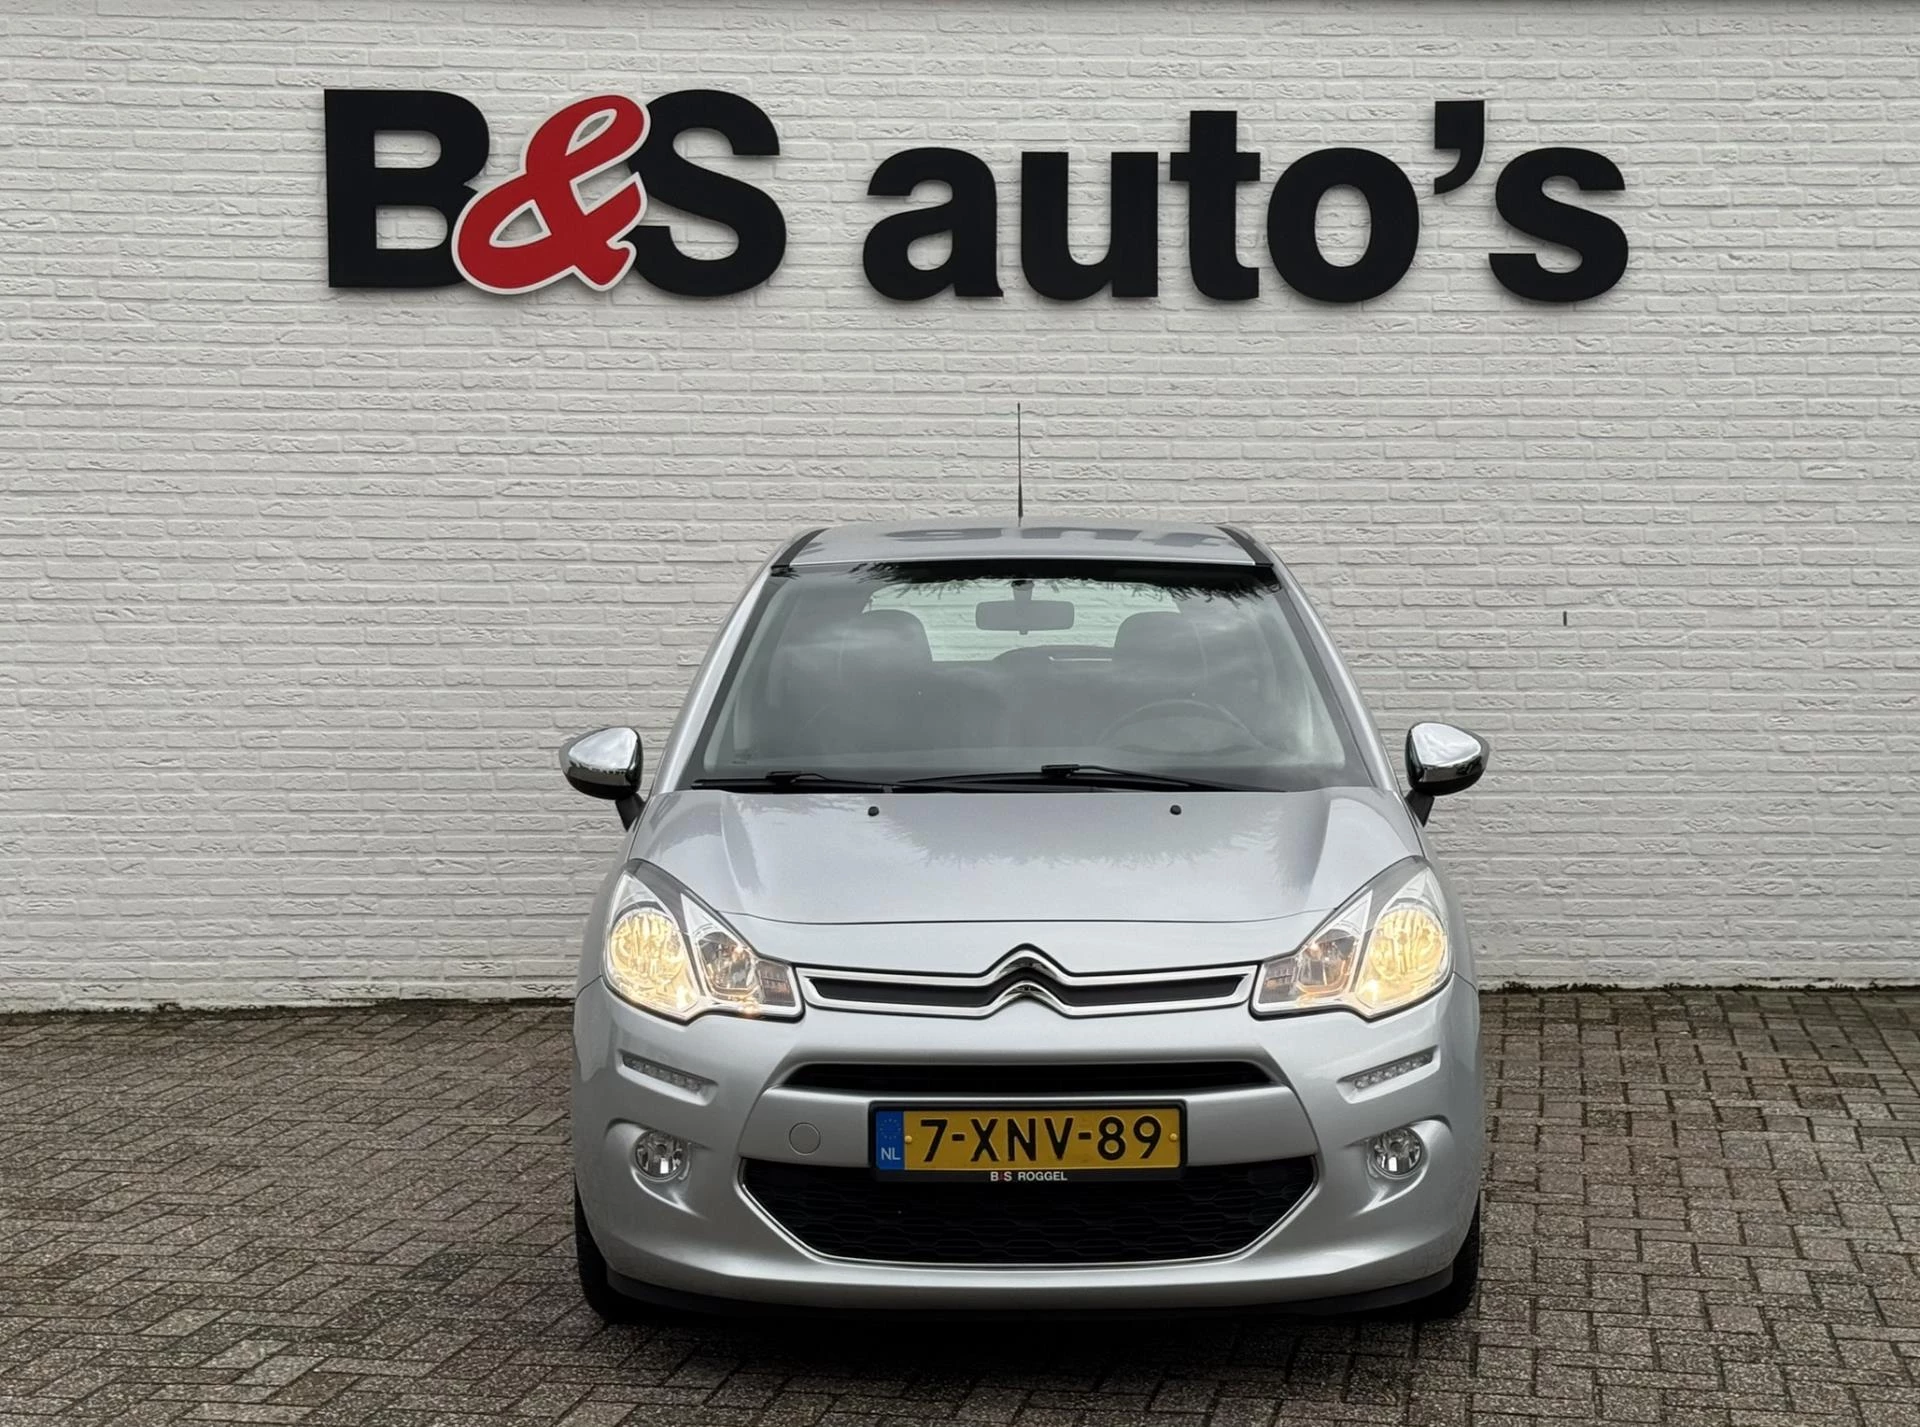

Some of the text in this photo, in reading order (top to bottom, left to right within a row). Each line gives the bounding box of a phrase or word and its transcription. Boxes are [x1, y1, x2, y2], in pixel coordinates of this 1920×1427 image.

[324, 88, 1628, 304] B&S auto's
[880, 1147, 901, 1161] NL
[920, 1116, 1162, 1162] 7-XNV-89
[990, 1171, 1068, 1182] BS ROGGEL
